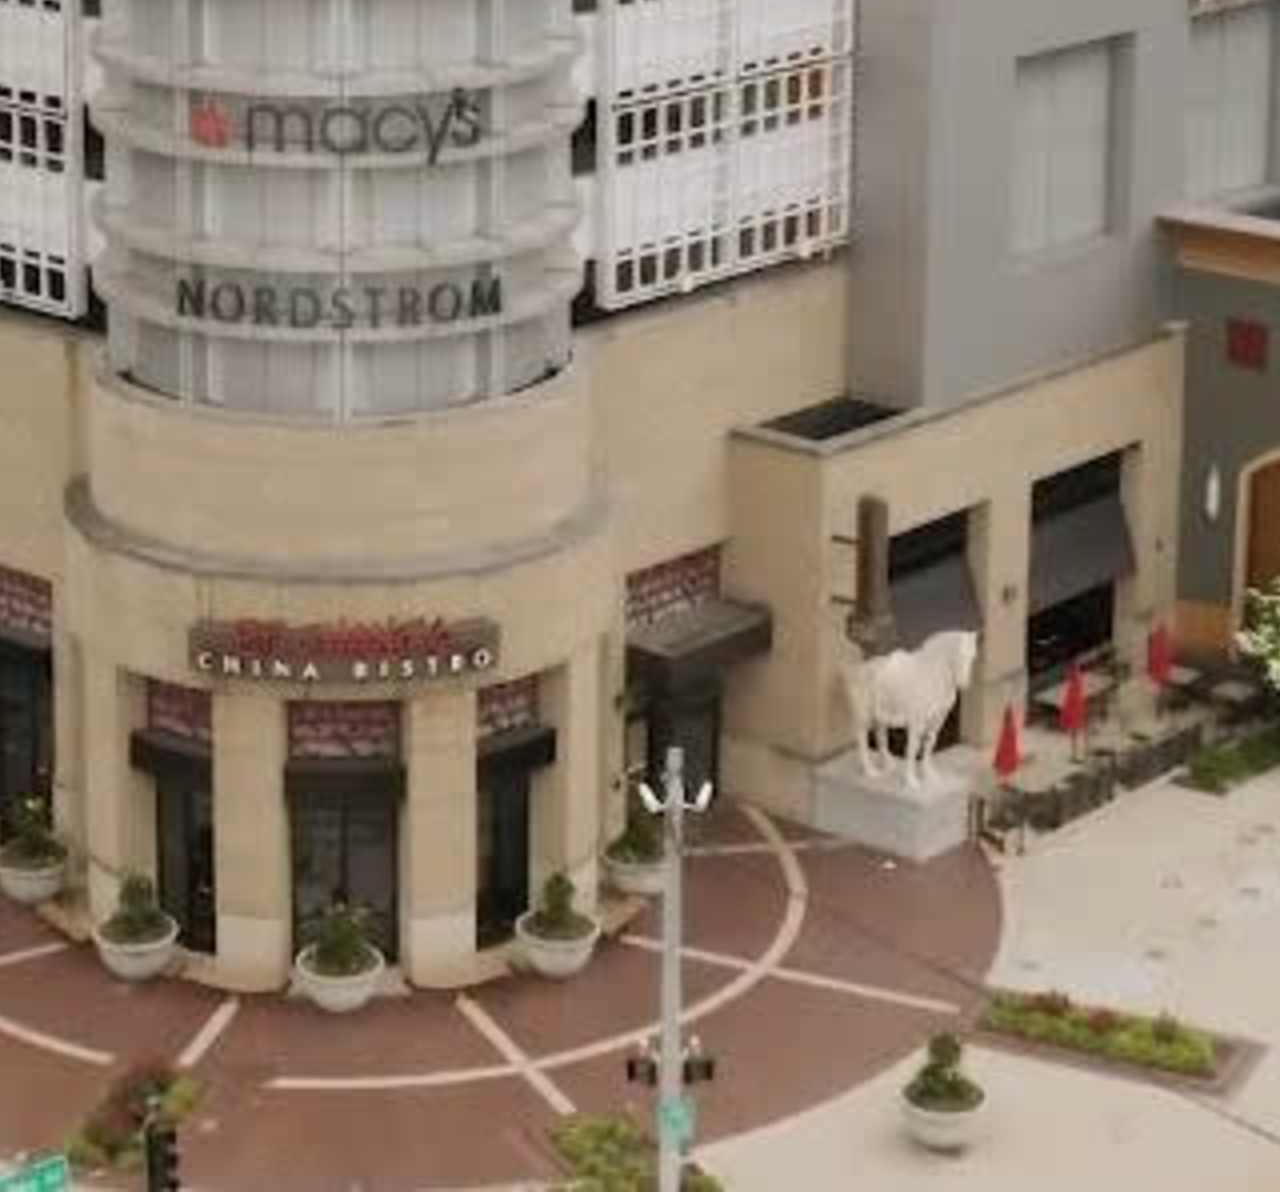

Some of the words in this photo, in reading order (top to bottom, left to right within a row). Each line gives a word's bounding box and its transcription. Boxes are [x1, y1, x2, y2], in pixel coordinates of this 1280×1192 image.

[246, 86, 482, 165] macy's
[176, 277, 502, 329] NORDSTROM
[198, 651, 320, 680] CHINA
[352, 646, 495, 679] BISTRO
